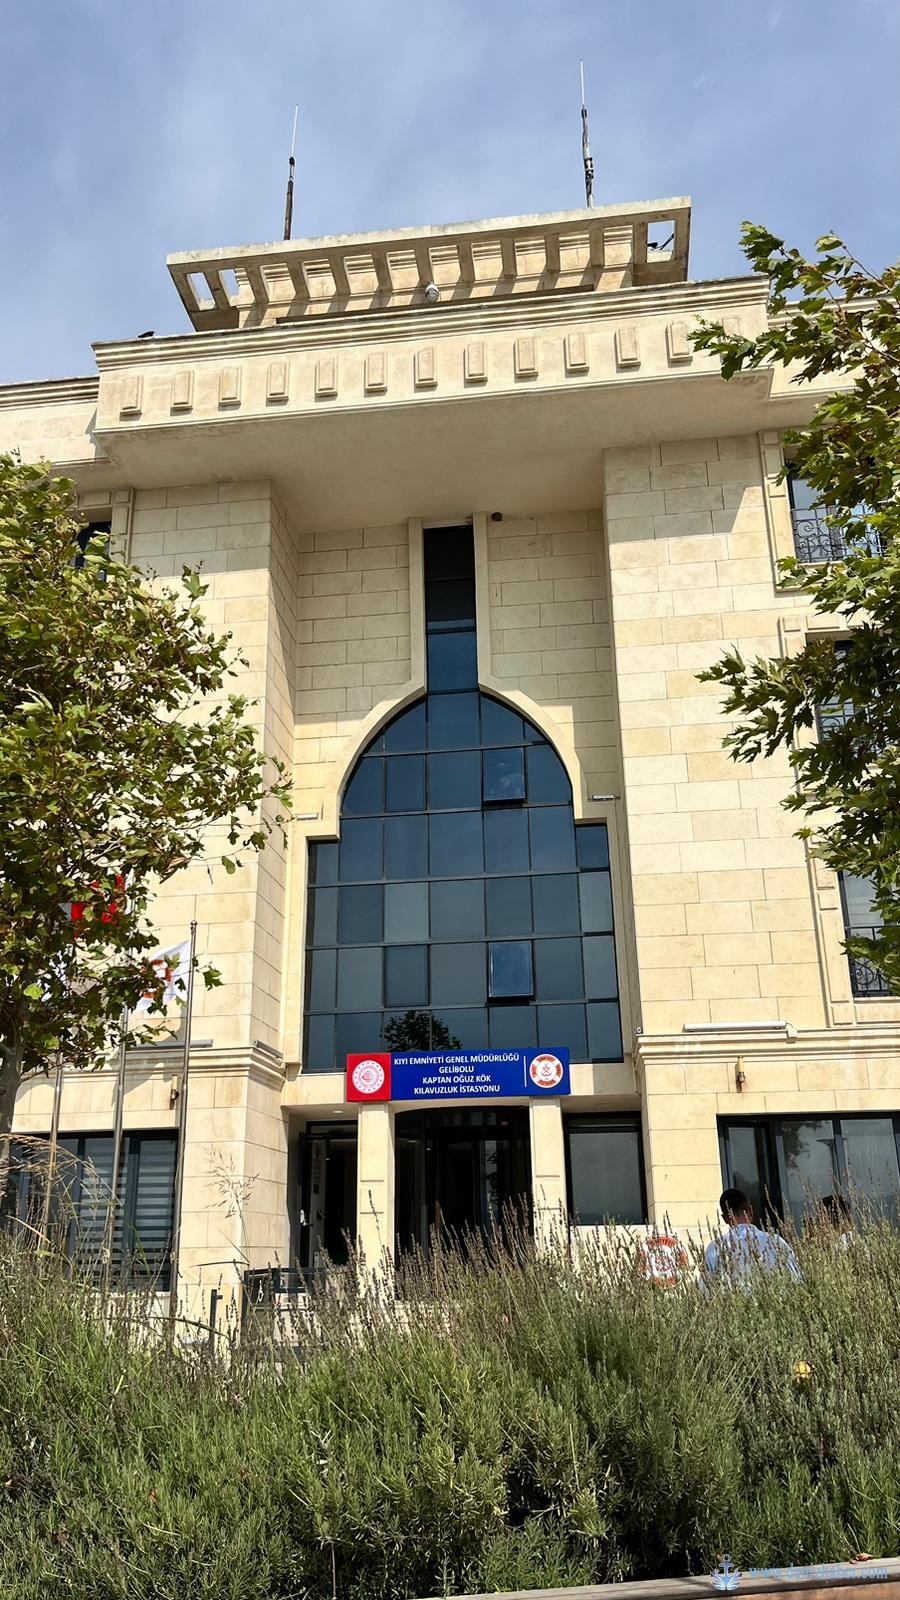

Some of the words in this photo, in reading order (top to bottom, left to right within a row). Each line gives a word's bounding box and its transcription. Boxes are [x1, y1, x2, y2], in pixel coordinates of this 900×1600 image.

[409, 1055, 444, 1065] EMNİYETİ
[445, 1056, 469, 1064] GENEL
[470, 1053, 520, 1063] MÜDÜRLÜĞÜ
[438, 1065, 474, 1074] GELİBOLU
[422, 1076, 452, 1084] KAPTAN
[453, 1074, 475, 1083] OĞUZ
[476, 1074, 492, 1082] KÖK
[414, 1086, 458, 1094] KILAVUZLUK
[459, 1085, 500, 1093] İSTASYONU
